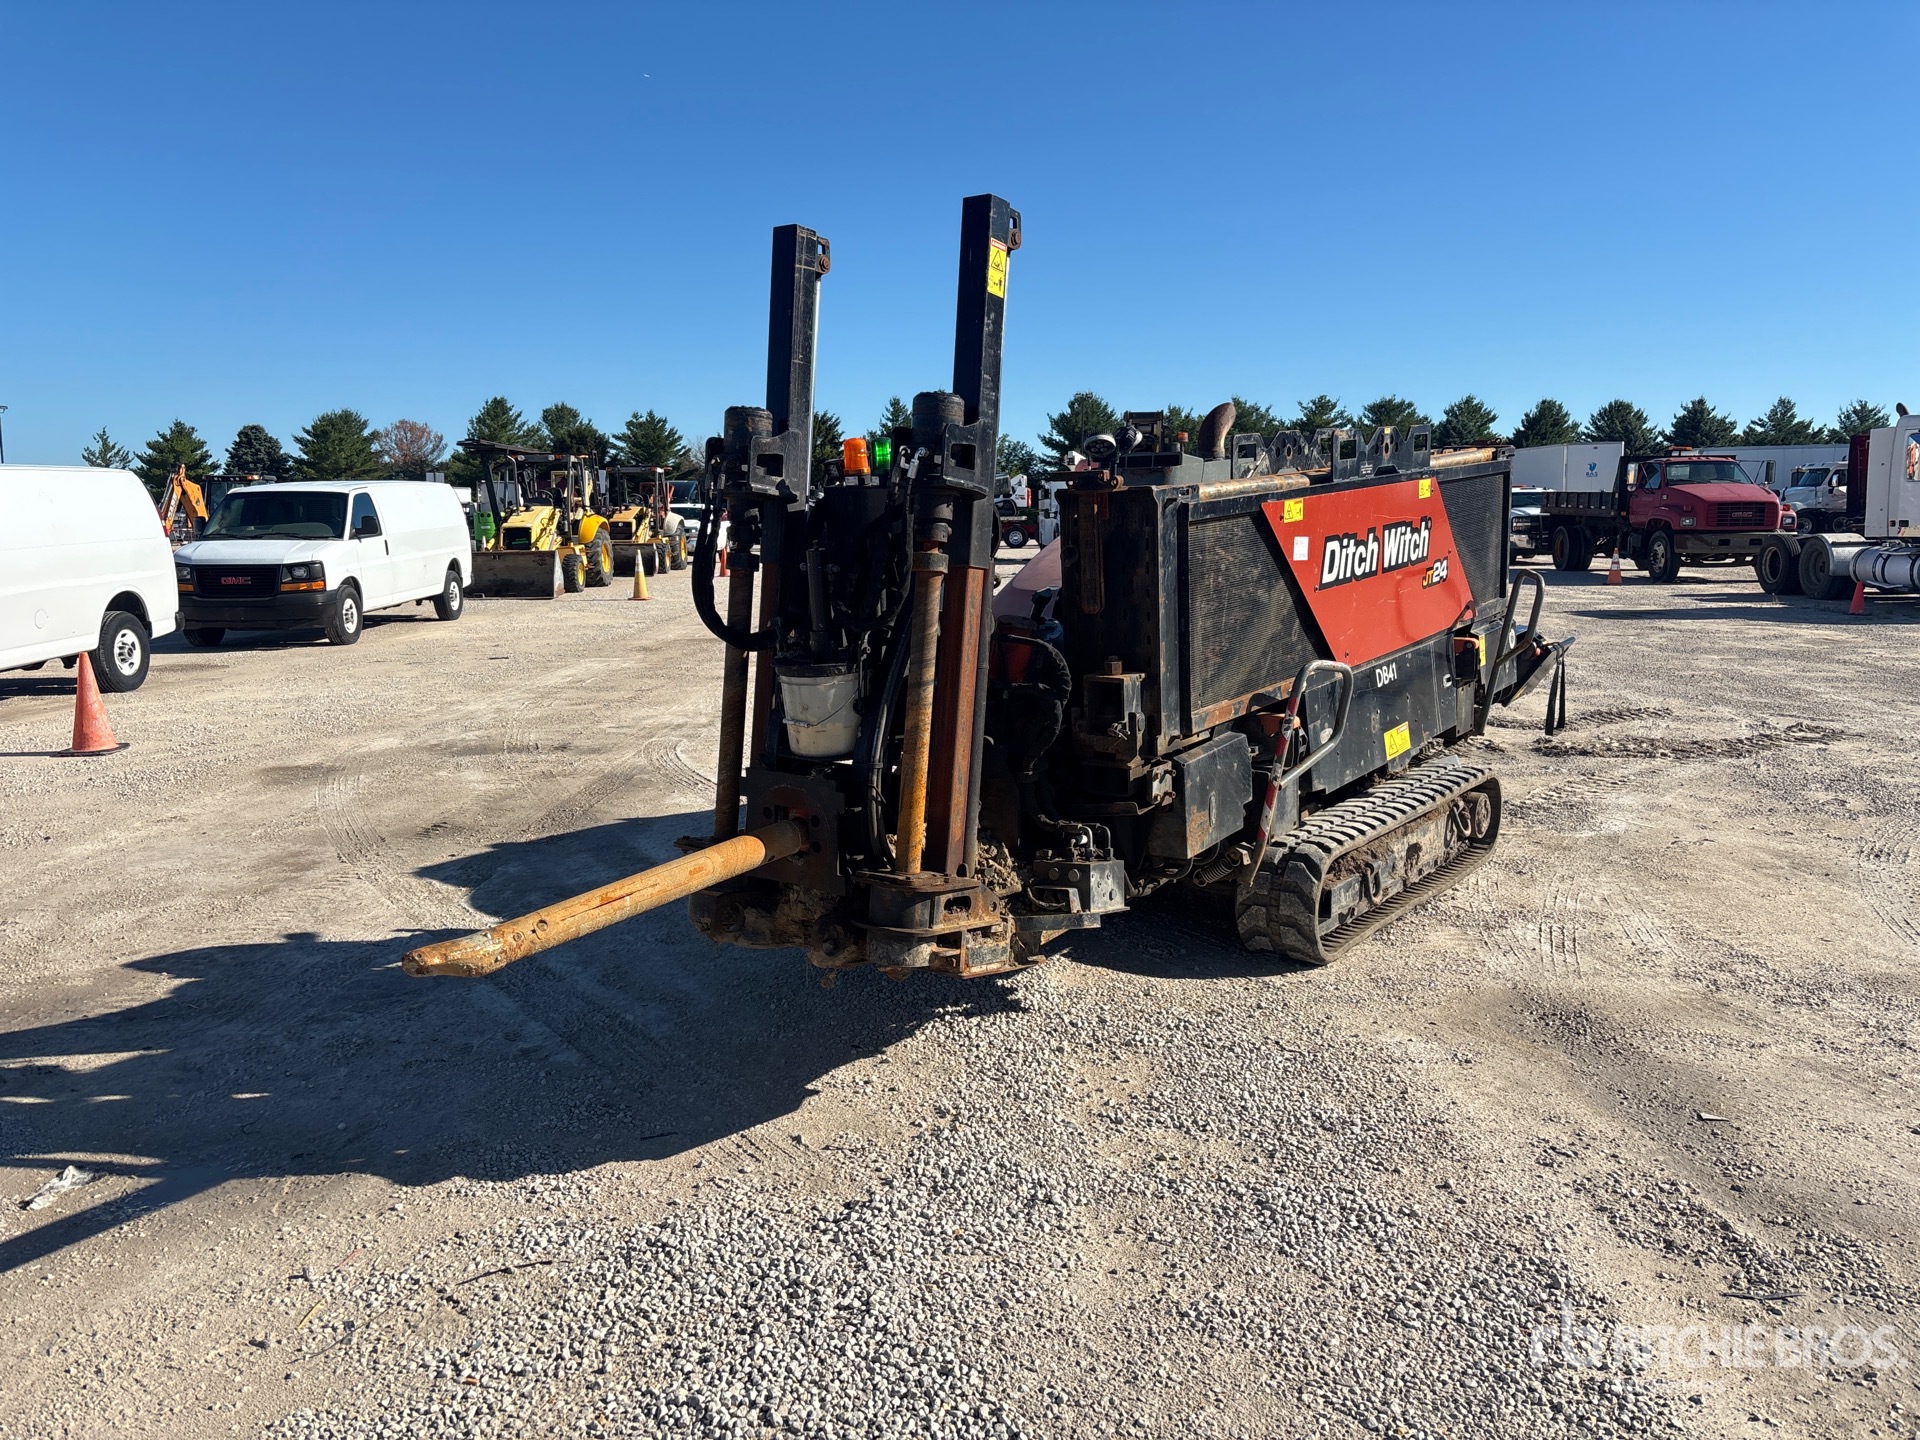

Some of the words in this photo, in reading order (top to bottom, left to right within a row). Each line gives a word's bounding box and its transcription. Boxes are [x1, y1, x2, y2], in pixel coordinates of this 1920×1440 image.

[1321, 532, 1379, 584] Ditch
[1383, 520, 1430, 569] Witch
[220, 576, 252, 585] GMC
[1422, 559, 1448, 587] JT24
[1375, 661, 1398, 688] DB41
